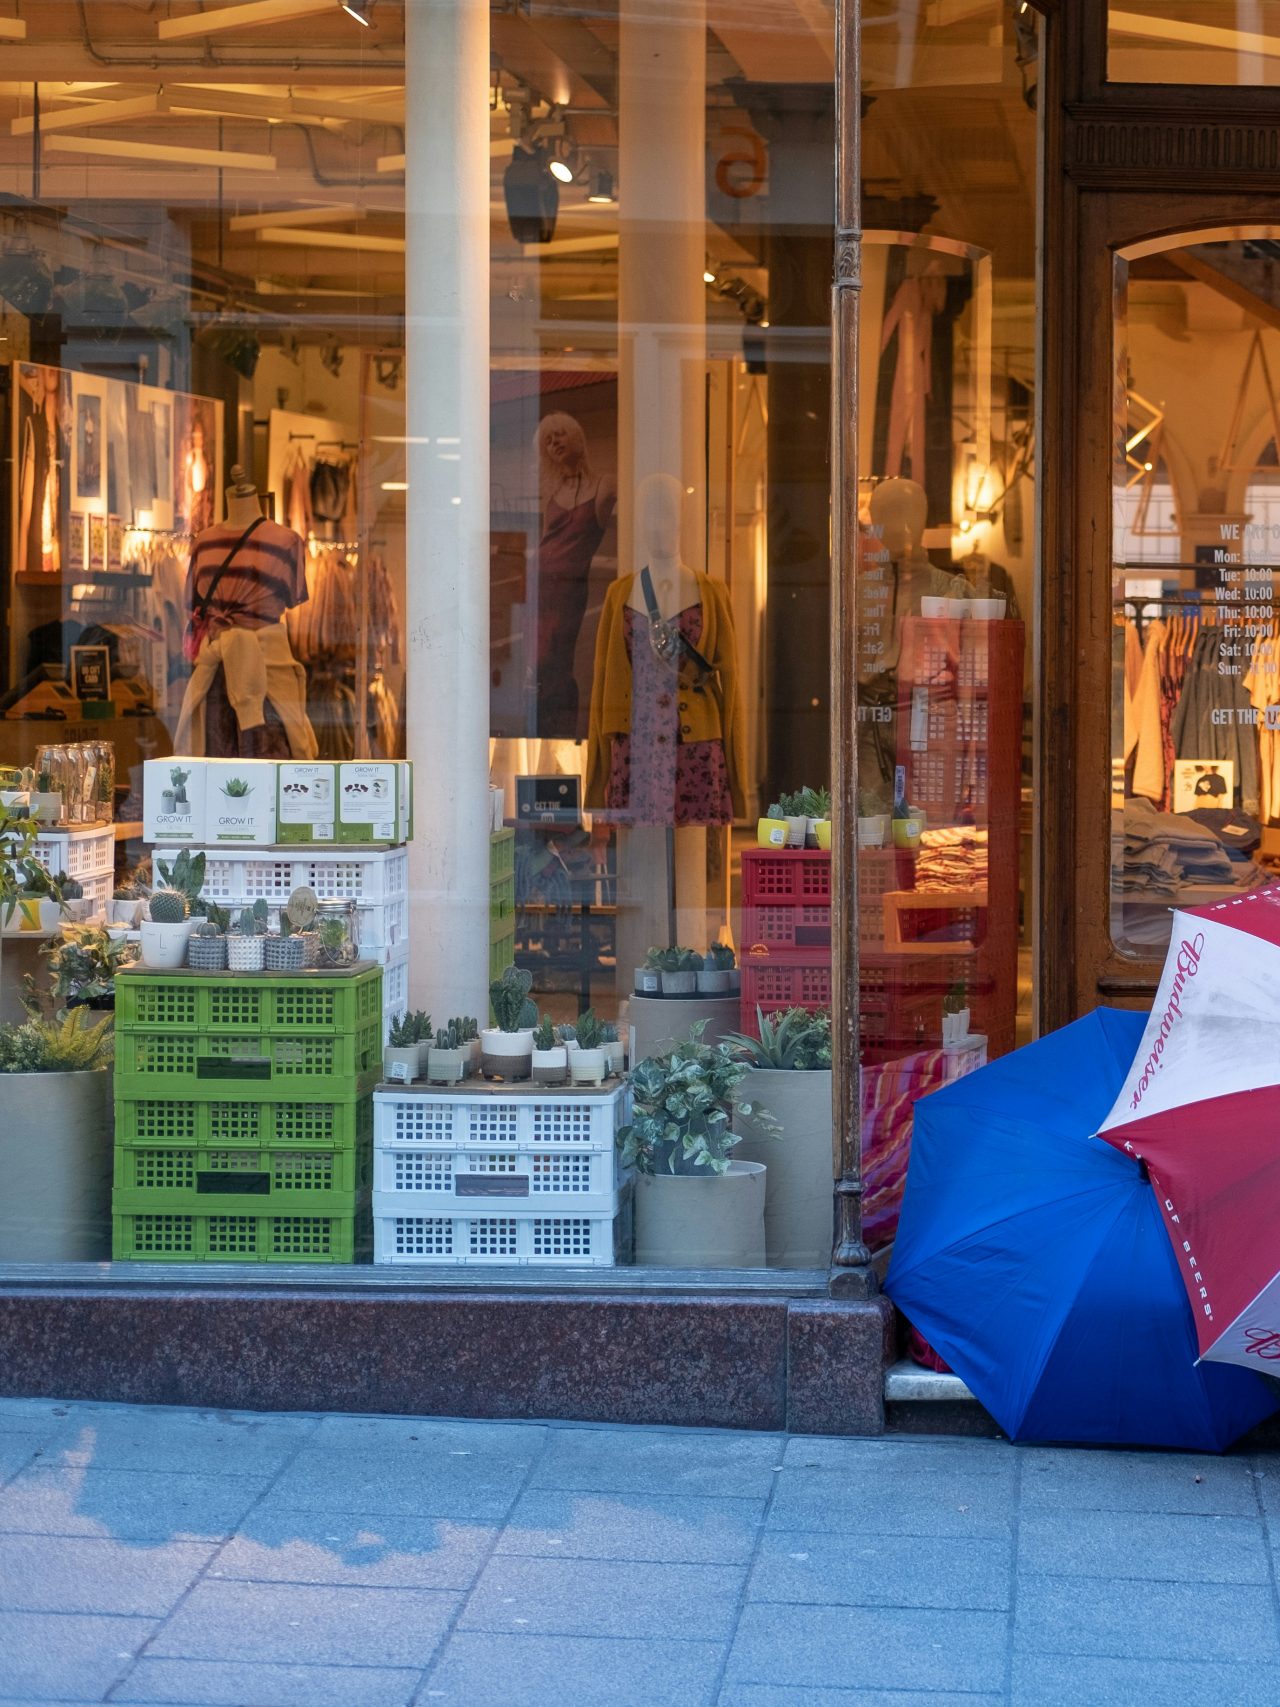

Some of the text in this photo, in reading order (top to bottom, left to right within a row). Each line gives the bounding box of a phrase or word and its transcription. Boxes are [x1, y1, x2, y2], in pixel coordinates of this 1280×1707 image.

[1220, 524, 1240, 540] WE
[1214, 549, 1241, 564] Mon:
[1218, 568, 1241, 582] Tue:
[1245, 568, 1273, 581] 10:00
[1215, 587, 1241, 600] Wed:
[1244, 587, 1273, 600] 10:00
[1218, 605, 1241, 619] Thu:
[1244, 605, 1273, 619] 10:00
[1223, 624, 1241, 638] Fri:
[1219, 643, 1241, 657] Sat:
[1245, 643, 1273, 656] 1000
[1218, 662, 1241, 675] Sun:
[1249, 662, 1277, 674] 1100
[1211, 708, 1234, 725] GET
[1236, 708, 1258, 725] THE
[156, 815, 193, 824] GROW IT
[218, 817, 255, 825] GROW IT
[1129, 932, 1205, 1110] Budweiser
[1164, 1199, 1212, 1316] OF BEERS
